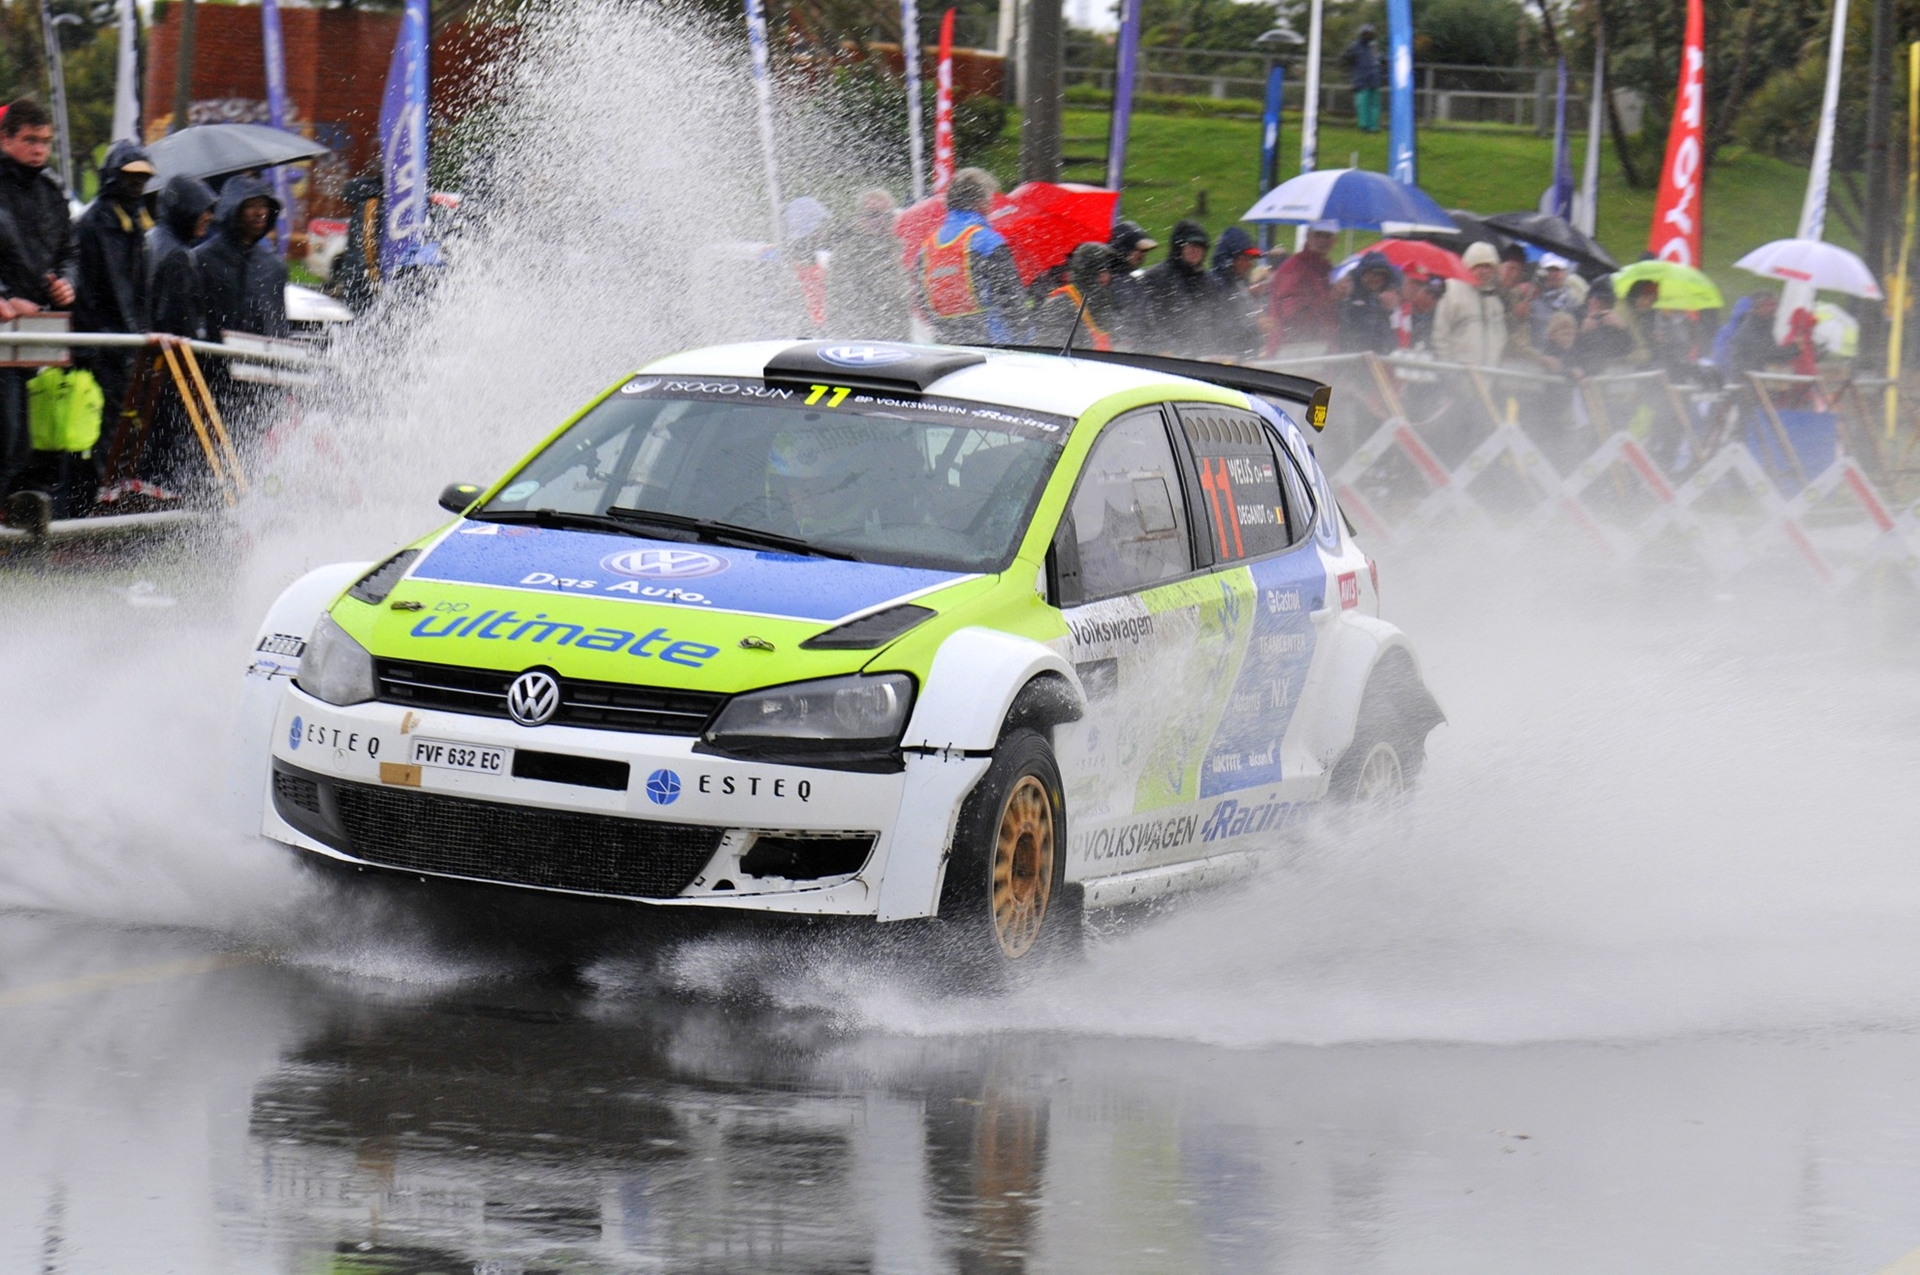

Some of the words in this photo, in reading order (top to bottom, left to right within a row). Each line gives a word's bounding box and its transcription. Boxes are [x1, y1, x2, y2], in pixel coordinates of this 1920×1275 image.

[661, 380, 740, 396] TSOGO
[741, 383, 793, 401] SUN
[804, 384, 851, 408] 11
[854, 395, 874, 404] BP
[876, 397, 968, 416] VOLKSWAGEN
[976, 409, 1061, 433] Racing
[1200, 456, 1245, 559] 11
[519, 571, 599, 590] Das
[605, 579, 713, 605] Auto.
[1275, 589, 1301, 613] Castrol
[1340, 577, 1357, 602] AVIS
[432, 600, 470, 614] bp
[410, 609, 721, 669] ultimate
[1067, 613, 1154, 647] Volkswagen
[1271, 676, 1292, 708] NX
[306, 723, 381, 759] ESTEQ
[415, 743, 443, 764] FVF
[447, 748, 475, 768] 632
[480, 751, 501, 771] EC
[698, 774, 812, 803] ESTEQ
[1082, 814, 1199, 862] VOLKSWAGEN
